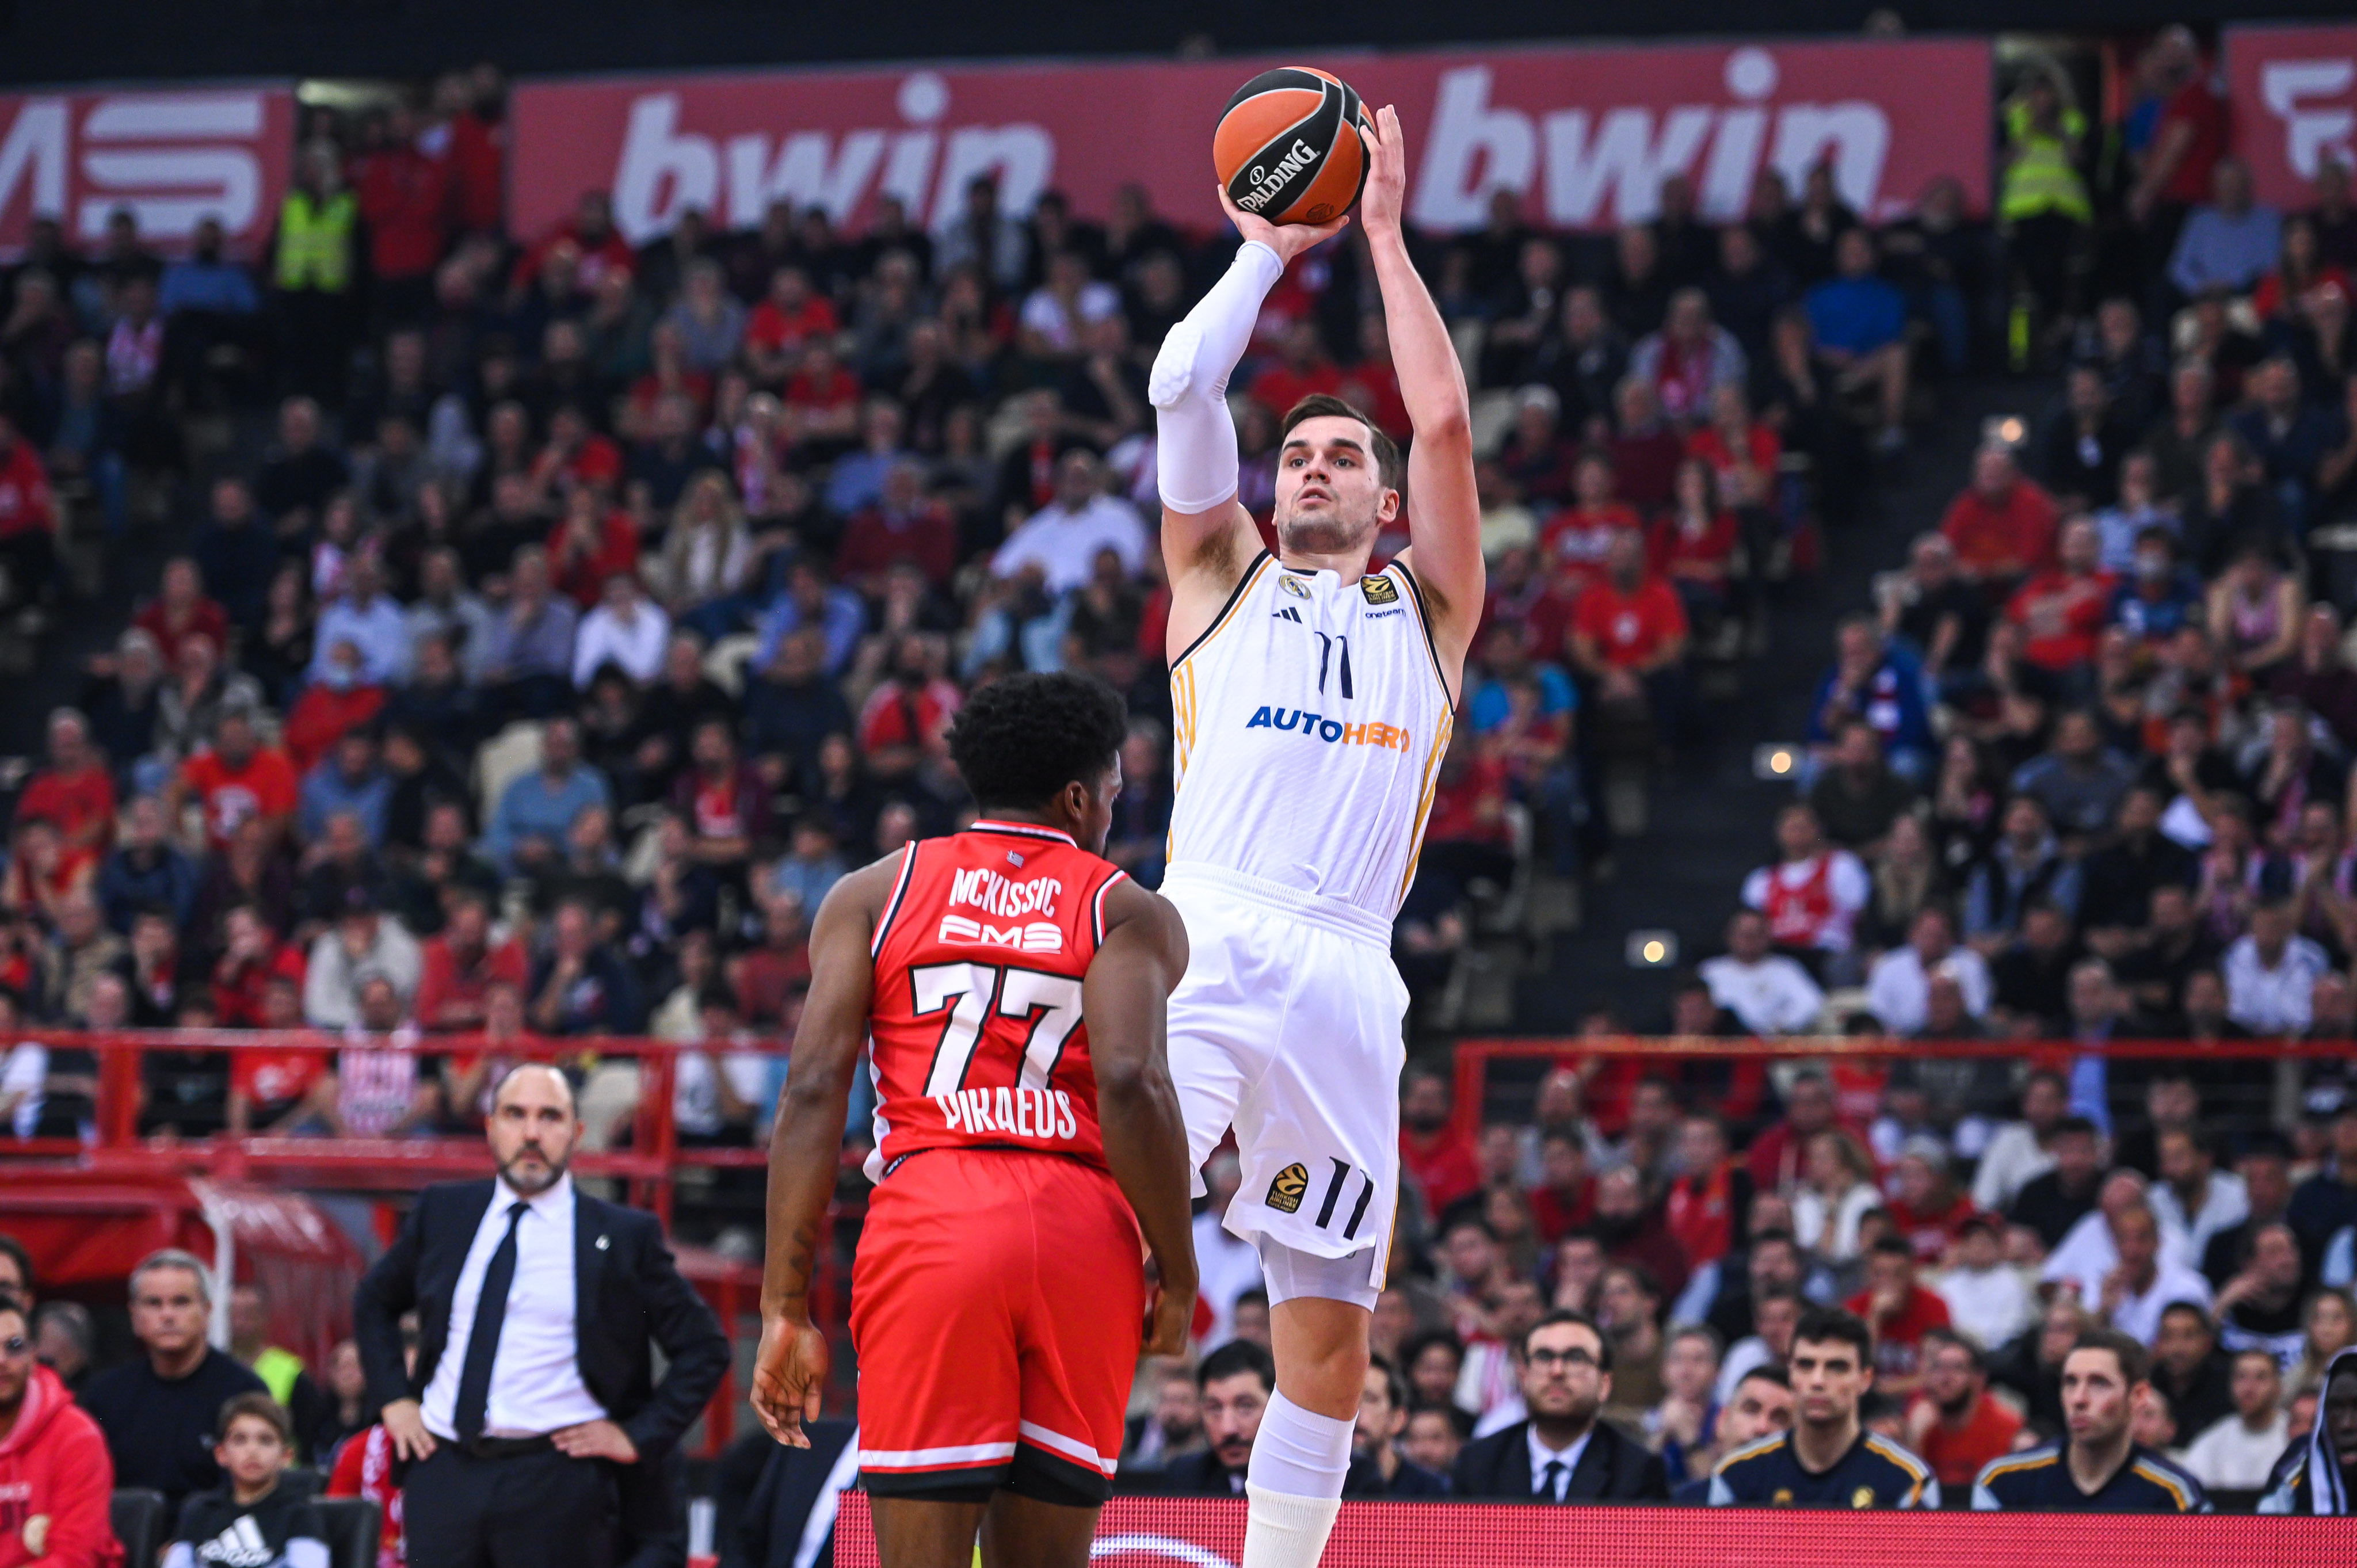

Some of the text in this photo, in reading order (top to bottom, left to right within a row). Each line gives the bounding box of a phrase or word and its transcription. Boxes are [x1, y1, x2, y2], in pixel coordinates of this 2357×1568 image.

[612, 72, 1054, 247] bwin
[1410, 47, 1889, 227] bwin
[1365, 608, 1406, 619] oneteam
[1314, 631, 1353, 699] 11
[948, 867, 1062, 918] MCKISSIC
[938, 914, 1063, 951] FMS
[907, 959, 1084, 1098] 77
[935, 1086, 1077, 1140] PIRAEUS
[1315, 1155, 1374, 1241] 11
